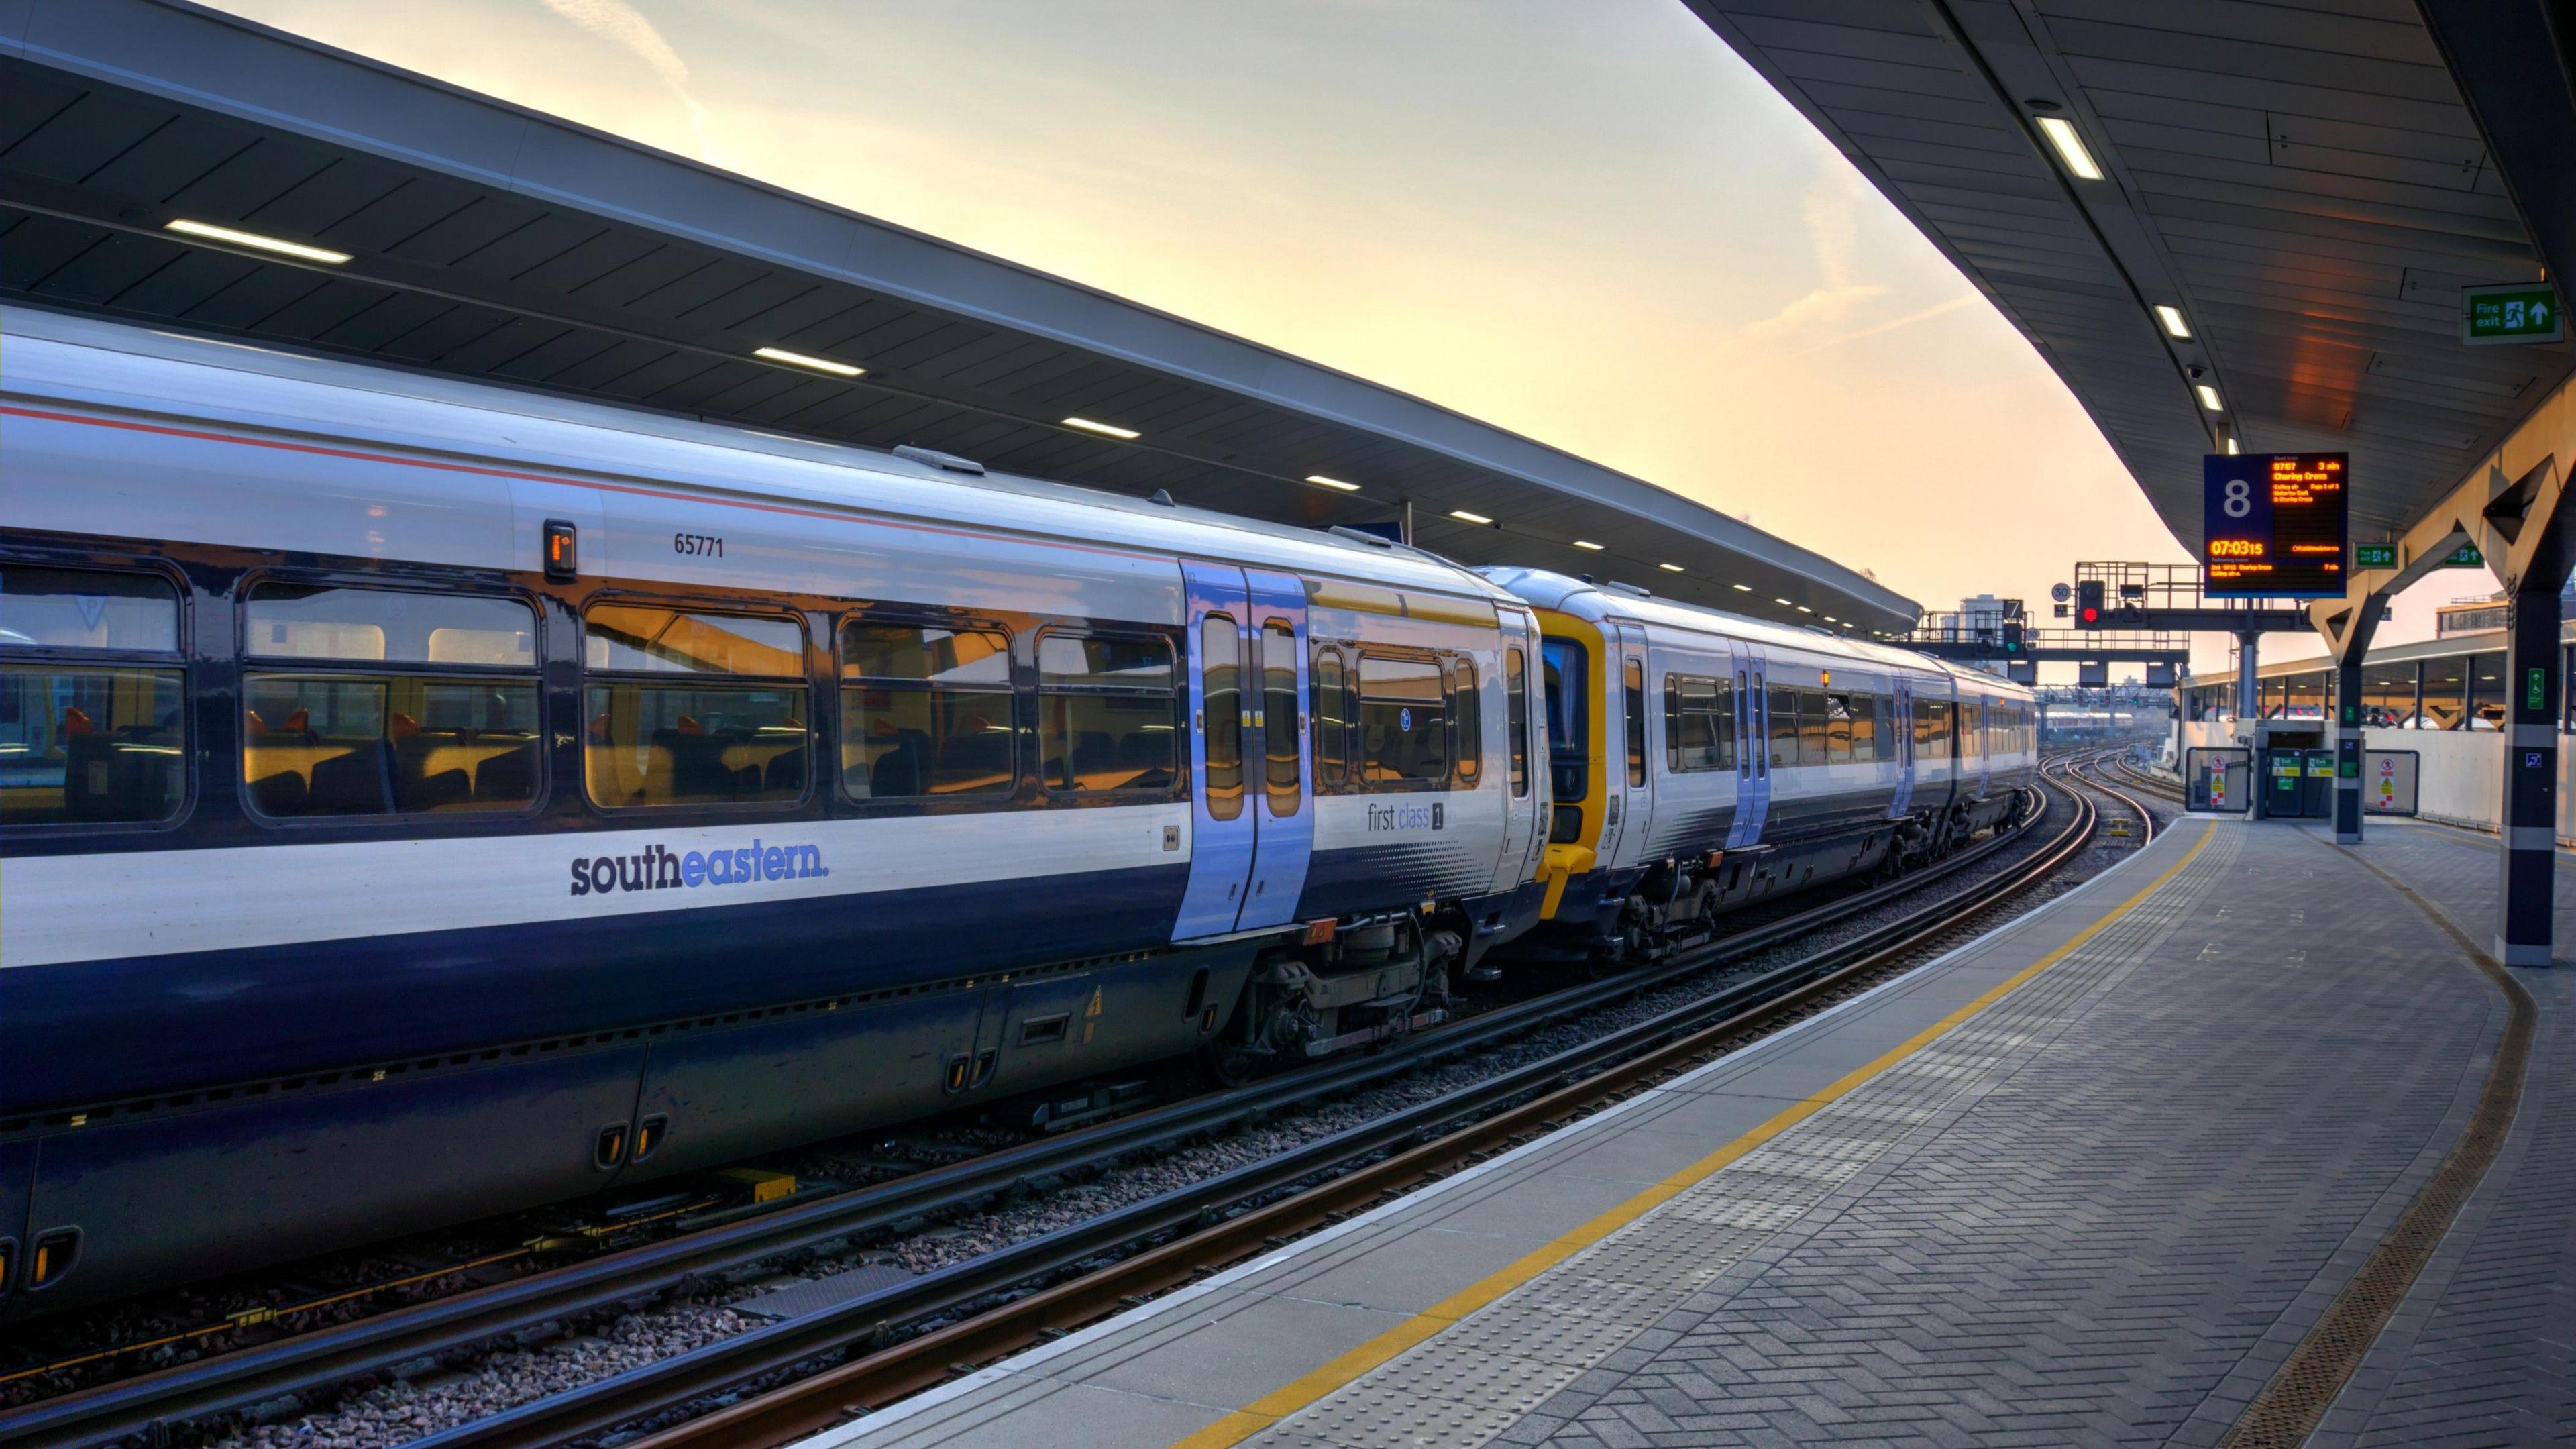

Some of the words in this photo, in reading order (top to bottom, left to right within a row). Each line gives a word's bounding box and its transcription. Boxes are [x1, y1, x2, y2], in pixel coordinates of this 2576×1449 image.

[2476, 303, 2500, 314] Fire
[2476, 315, 2500, 327] exit
[2318, 462, 2325, 470] 3
[2273, 472, 2303, 481] Charing
[2304, 472, 2328, 480] Cross
[2224, 479, 2251, 518] 8
[674, 533, 723, 558] 65771
[2054, 588, 2068, 597] 30
[2008, 600, 2020, 617] 7
[1368, 803, 1395, 831] first
[1399, 802, 1429, 829] class
